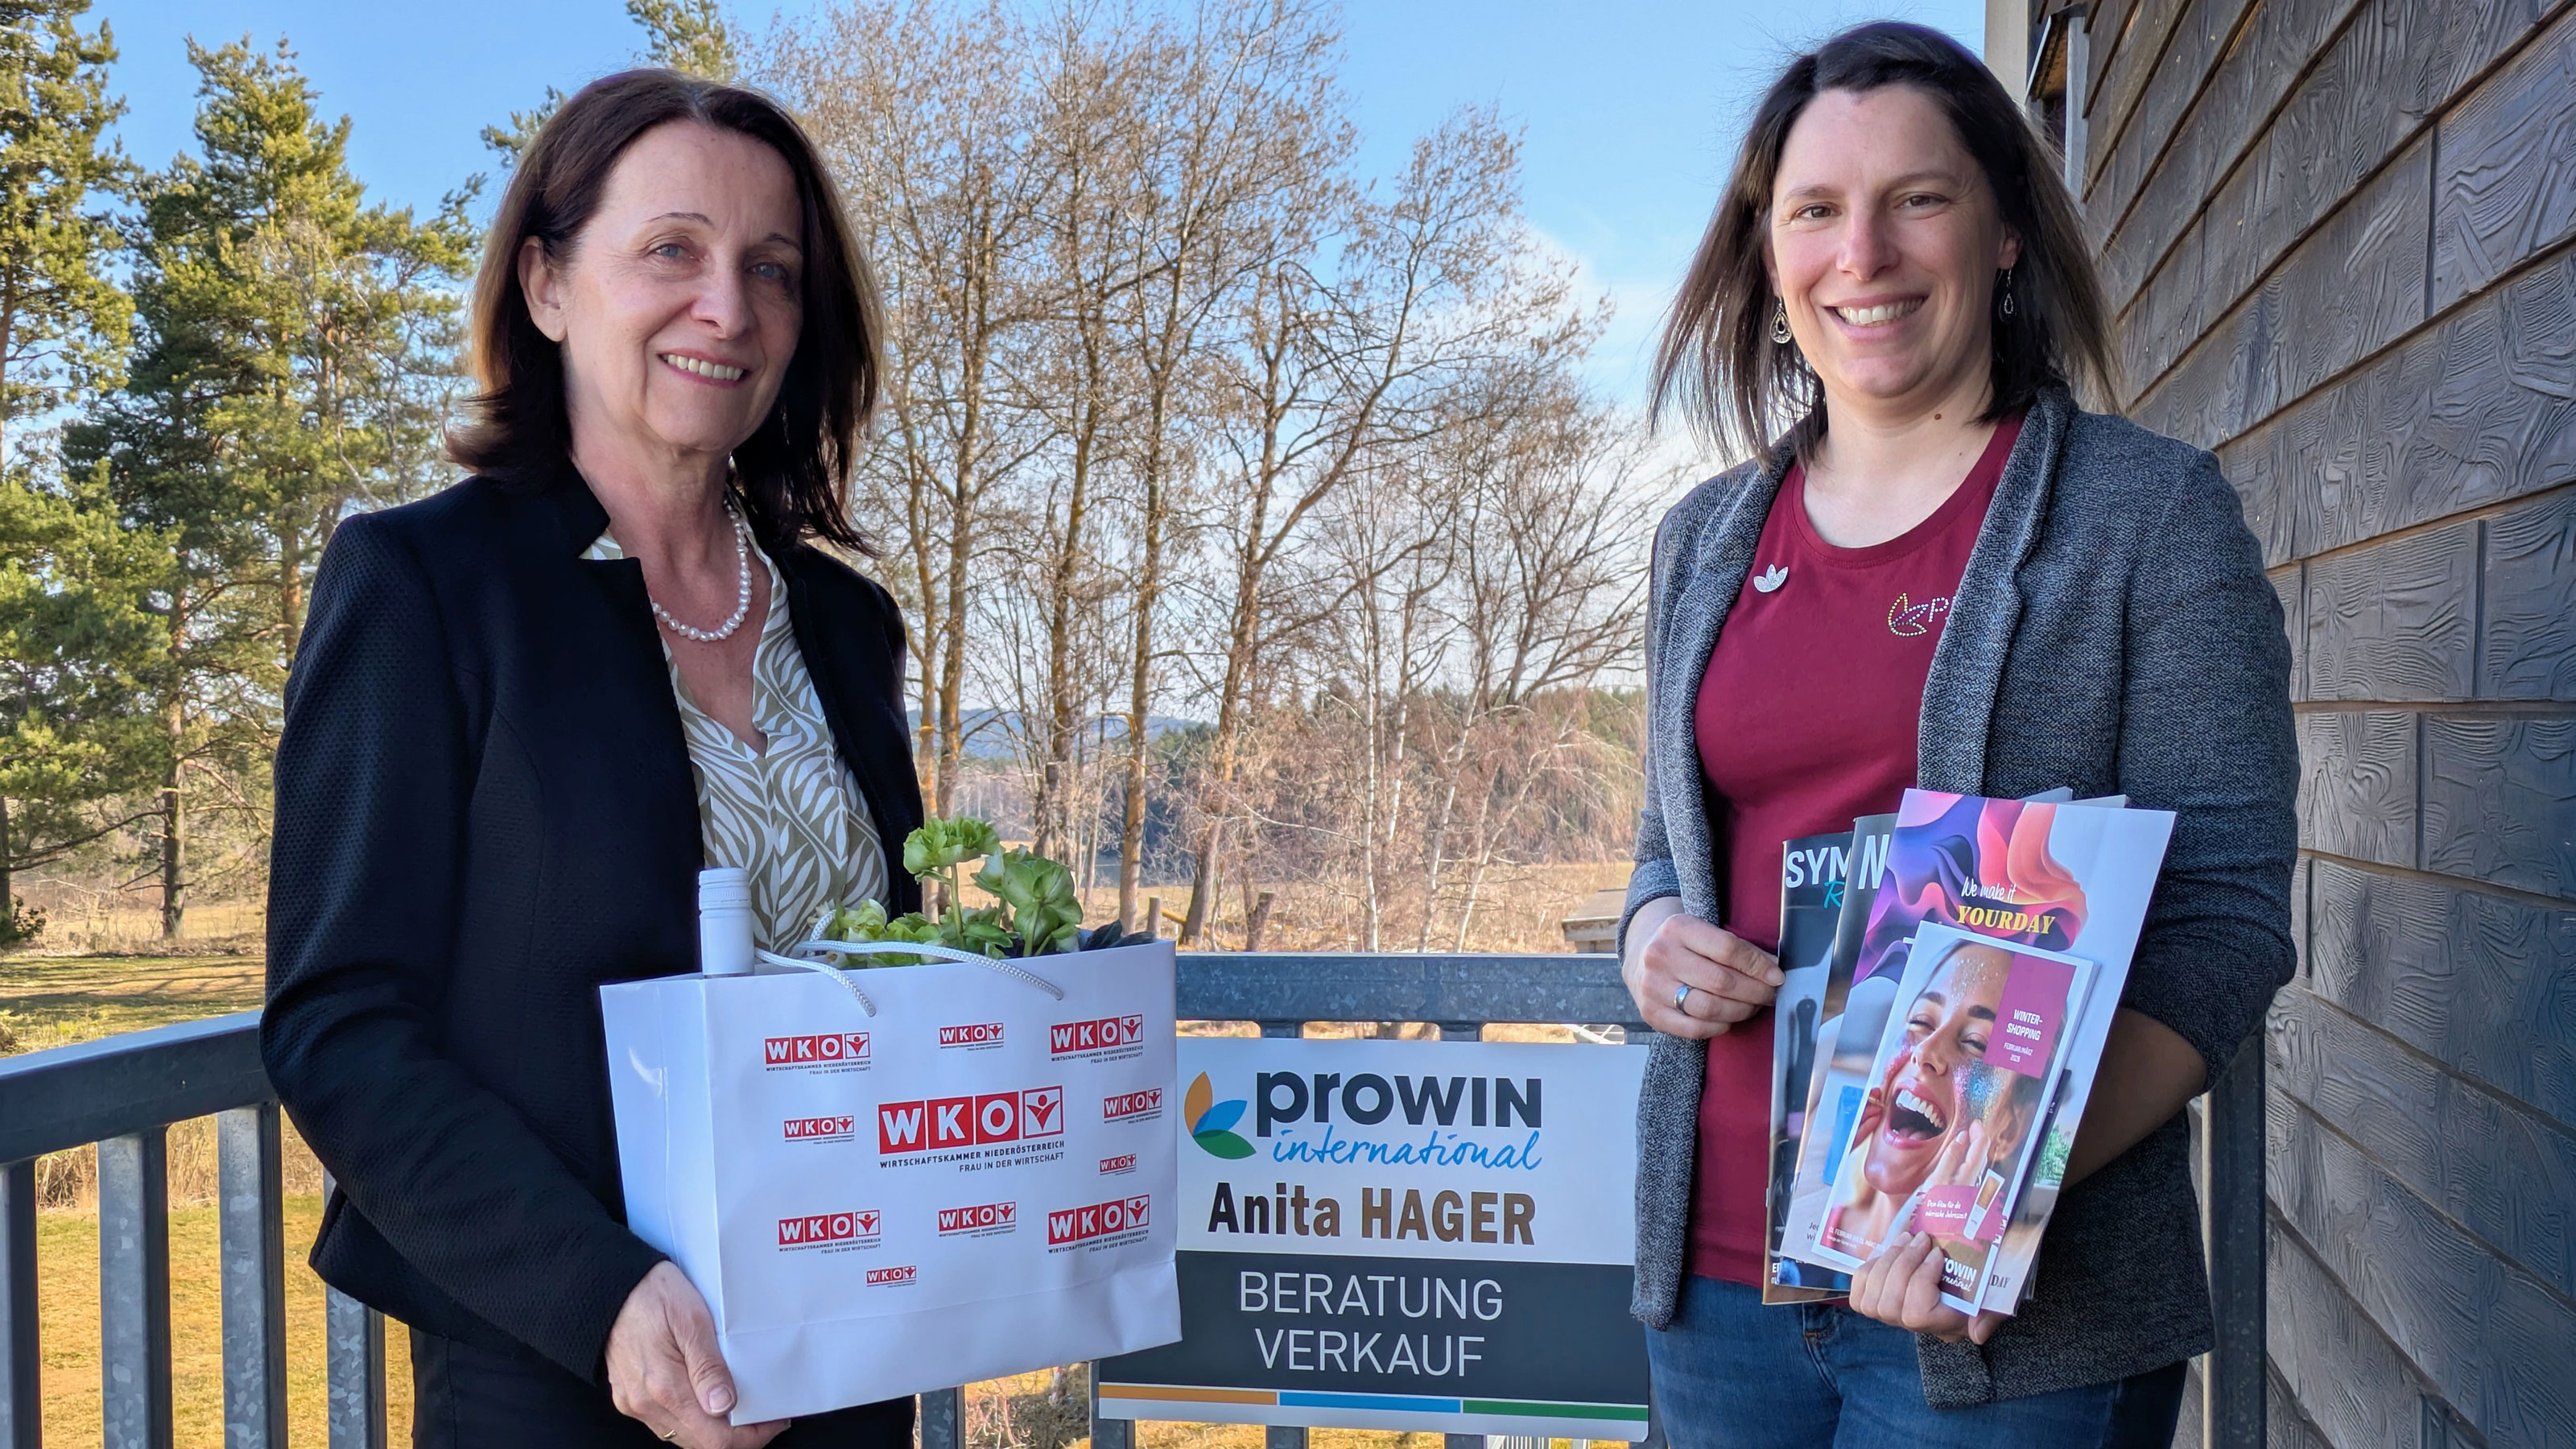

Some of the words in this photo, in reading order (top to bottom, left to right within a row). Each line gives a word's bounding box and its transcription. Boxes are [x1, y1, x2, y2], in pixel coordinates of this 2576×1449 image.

[1961, 876, 1977, 898] We
[1979, 882, 2004, 901] make
[2007, 883, 2017, 903] it
[1957, 905, 2056, 935] YOURDAY
[2013, 1009, 2043, 1026] WINTER-
[940, 1026, 987, 1042] WKO
[1051, 1020, 1119, 1051] WKO
[2006, 1022, 2041, 1041] SHOPPING
[766, 1035, 841, 1062] WKO
[1051, 1052, 1102, 1063] WIRTSCHAFTSKAMMER
[1118, 1051, 1143, 1060] WIRTSCHAFT
[1104, 1093, 1146, 1116] WKO
[785, 1119, 836, 1136] WKO
[881, 1097, 1015, 1147] WKO
[880, 1151, 981, 1169] WIRTSCHAFTSKAMMER
[984, 1140, 1065, 1158] NIEDERÖSTERREICH
[1273, 1125, 1542, 1170] international
[959, 1162, 982, 1173] FRAU
[984, 1161, 993, 1170] IN
[996, 1158, 1013, 1168] DER
[1014, 1151, 1064, 1166] WIRTSCHAFT
[1100, 1157, 1127, 1170] WKO
[939, 1207, 995, 1229] WKO
[1050, 1203, 1123, 1241] WKO
[1208, 1182, 1341, 1237] Anita
[1361, 1187, 1536, 1245] HAGER
[780, 1215, 852, 1242] WKO
[779, 1242, 833, 1253] WIRTSCHAFTSKAMMER
[1048, 1238, 1102, 1254] WIRTSCHAFTSKAMMER
[1104, 1229, 1150, 1243] NIEDERÖSTERREICH
[1089, 1245, 1103, 1253] FRAU
[1108, 1241, 1118, 1249] DER
[1118, 1236, 1148, 1247] WIRTSCHAFT
[868, 1268, 903, 1282] WKO
[1943, 1257, 1978, 1283] OWIN
[1241, 1271, 1503, 1321] BERATUNG
[1254, 1327, 1485, 1377] VERKAUF
